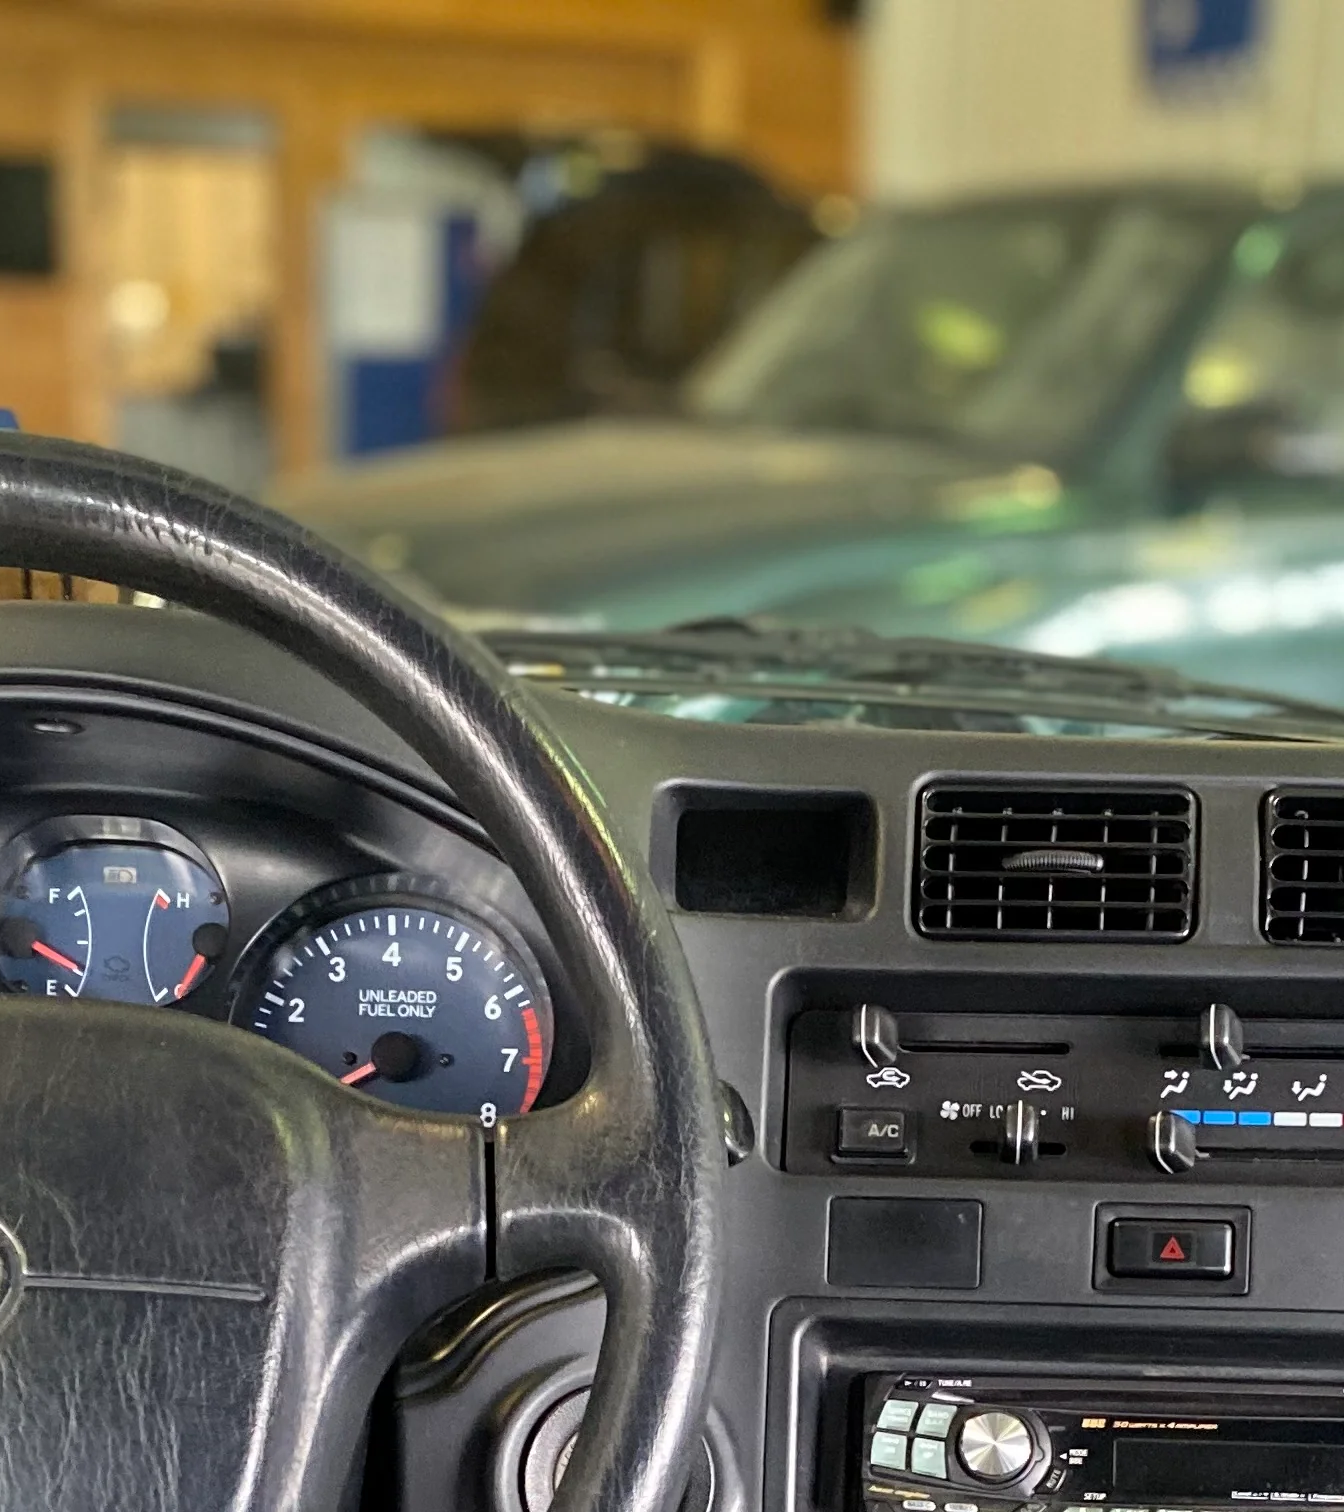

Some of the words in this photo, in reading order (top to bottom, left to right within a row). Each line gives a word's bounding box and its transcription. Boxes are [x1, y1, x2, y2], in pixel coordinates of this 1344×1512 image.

[50, 888, 60, 903] F
[177, 890, 191, 908] H
[382, 942, 401, 966] 4
[329, 957, 345, 982] 3
[447, 957, 462, 981] 5
[47, 980, 57, 995] E
[360, 990, 436, 1003] UNLEADED
[289, 998, 304, 1022] 2
[358, 1003, 396, 1017] FUEL
[397, 1004, 436, 1018] ONLY
[485, 995, 501, 1019] 6
[501, 1049, 518, 1072] 7
[480, 1103, 496, 1127] 8
[962, 1103, 983, 1118] OFF
[1061, 1106, 1075, 1120] HI
[868, 1123, 899, 1138] A/C
[1083, 1491, 1107, 1501] SETUP
